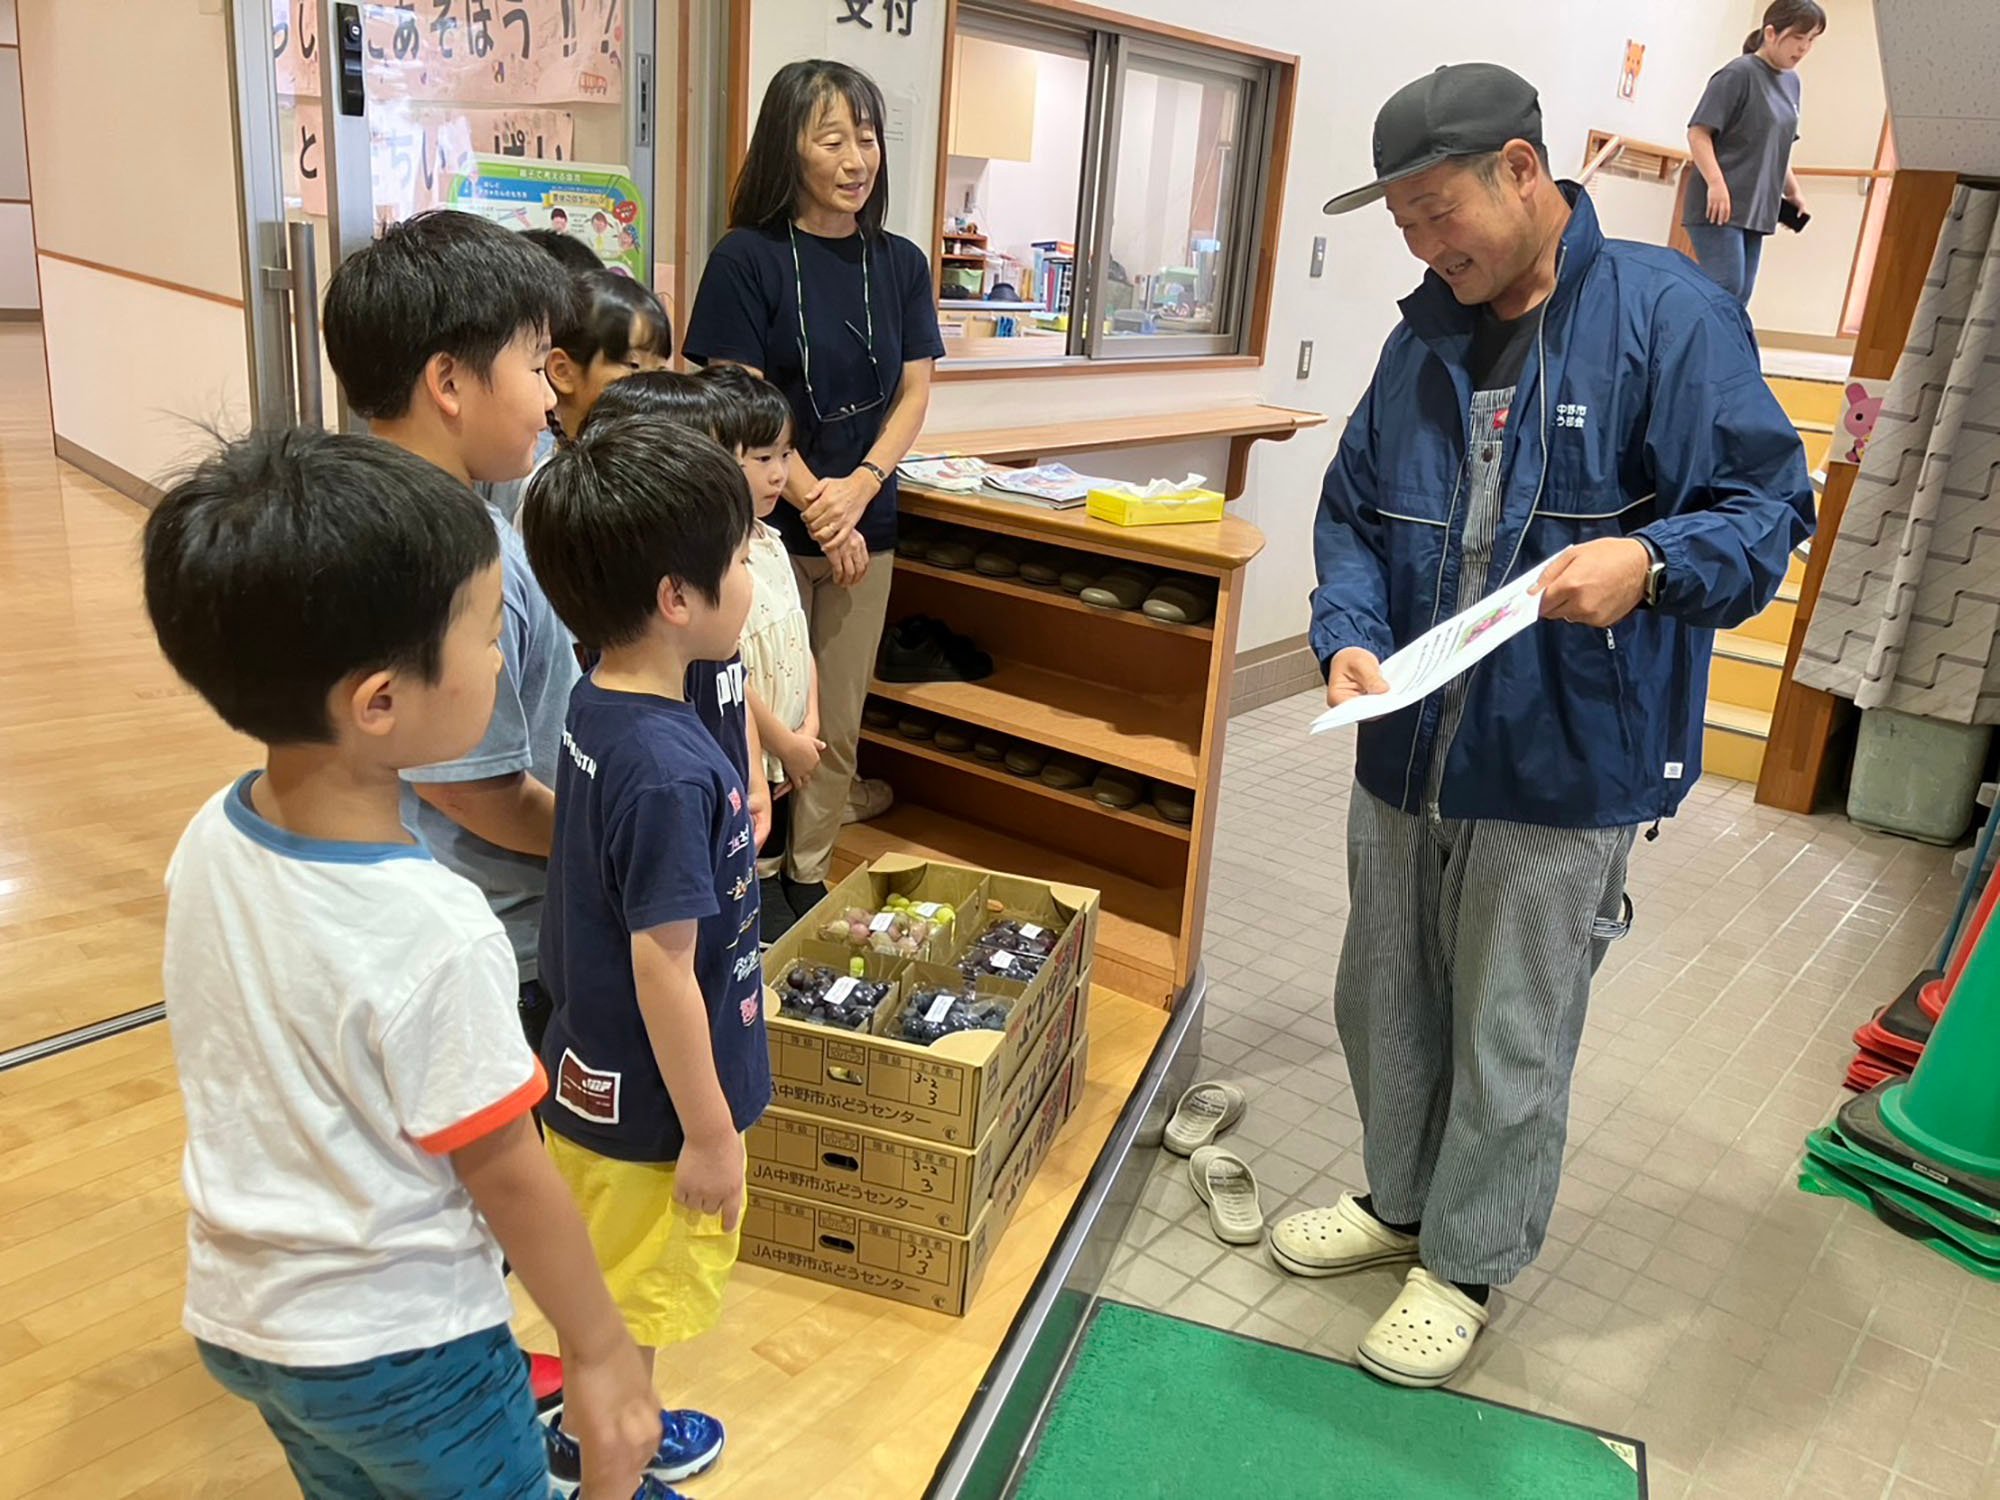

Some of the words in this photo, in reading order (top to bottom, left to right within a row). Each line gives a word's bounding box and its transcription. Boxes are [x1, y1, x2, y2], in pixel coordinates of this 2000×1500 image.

[770, 1082, 932, 1125] A中野市ぶどうセンター
[753, 1164, 925, 1210] JA中野市ぶどうセンター
[921, 1178, 933, 1193] 3
[751, 1244, 921, 1292] JA中野市ぶどうセンター
